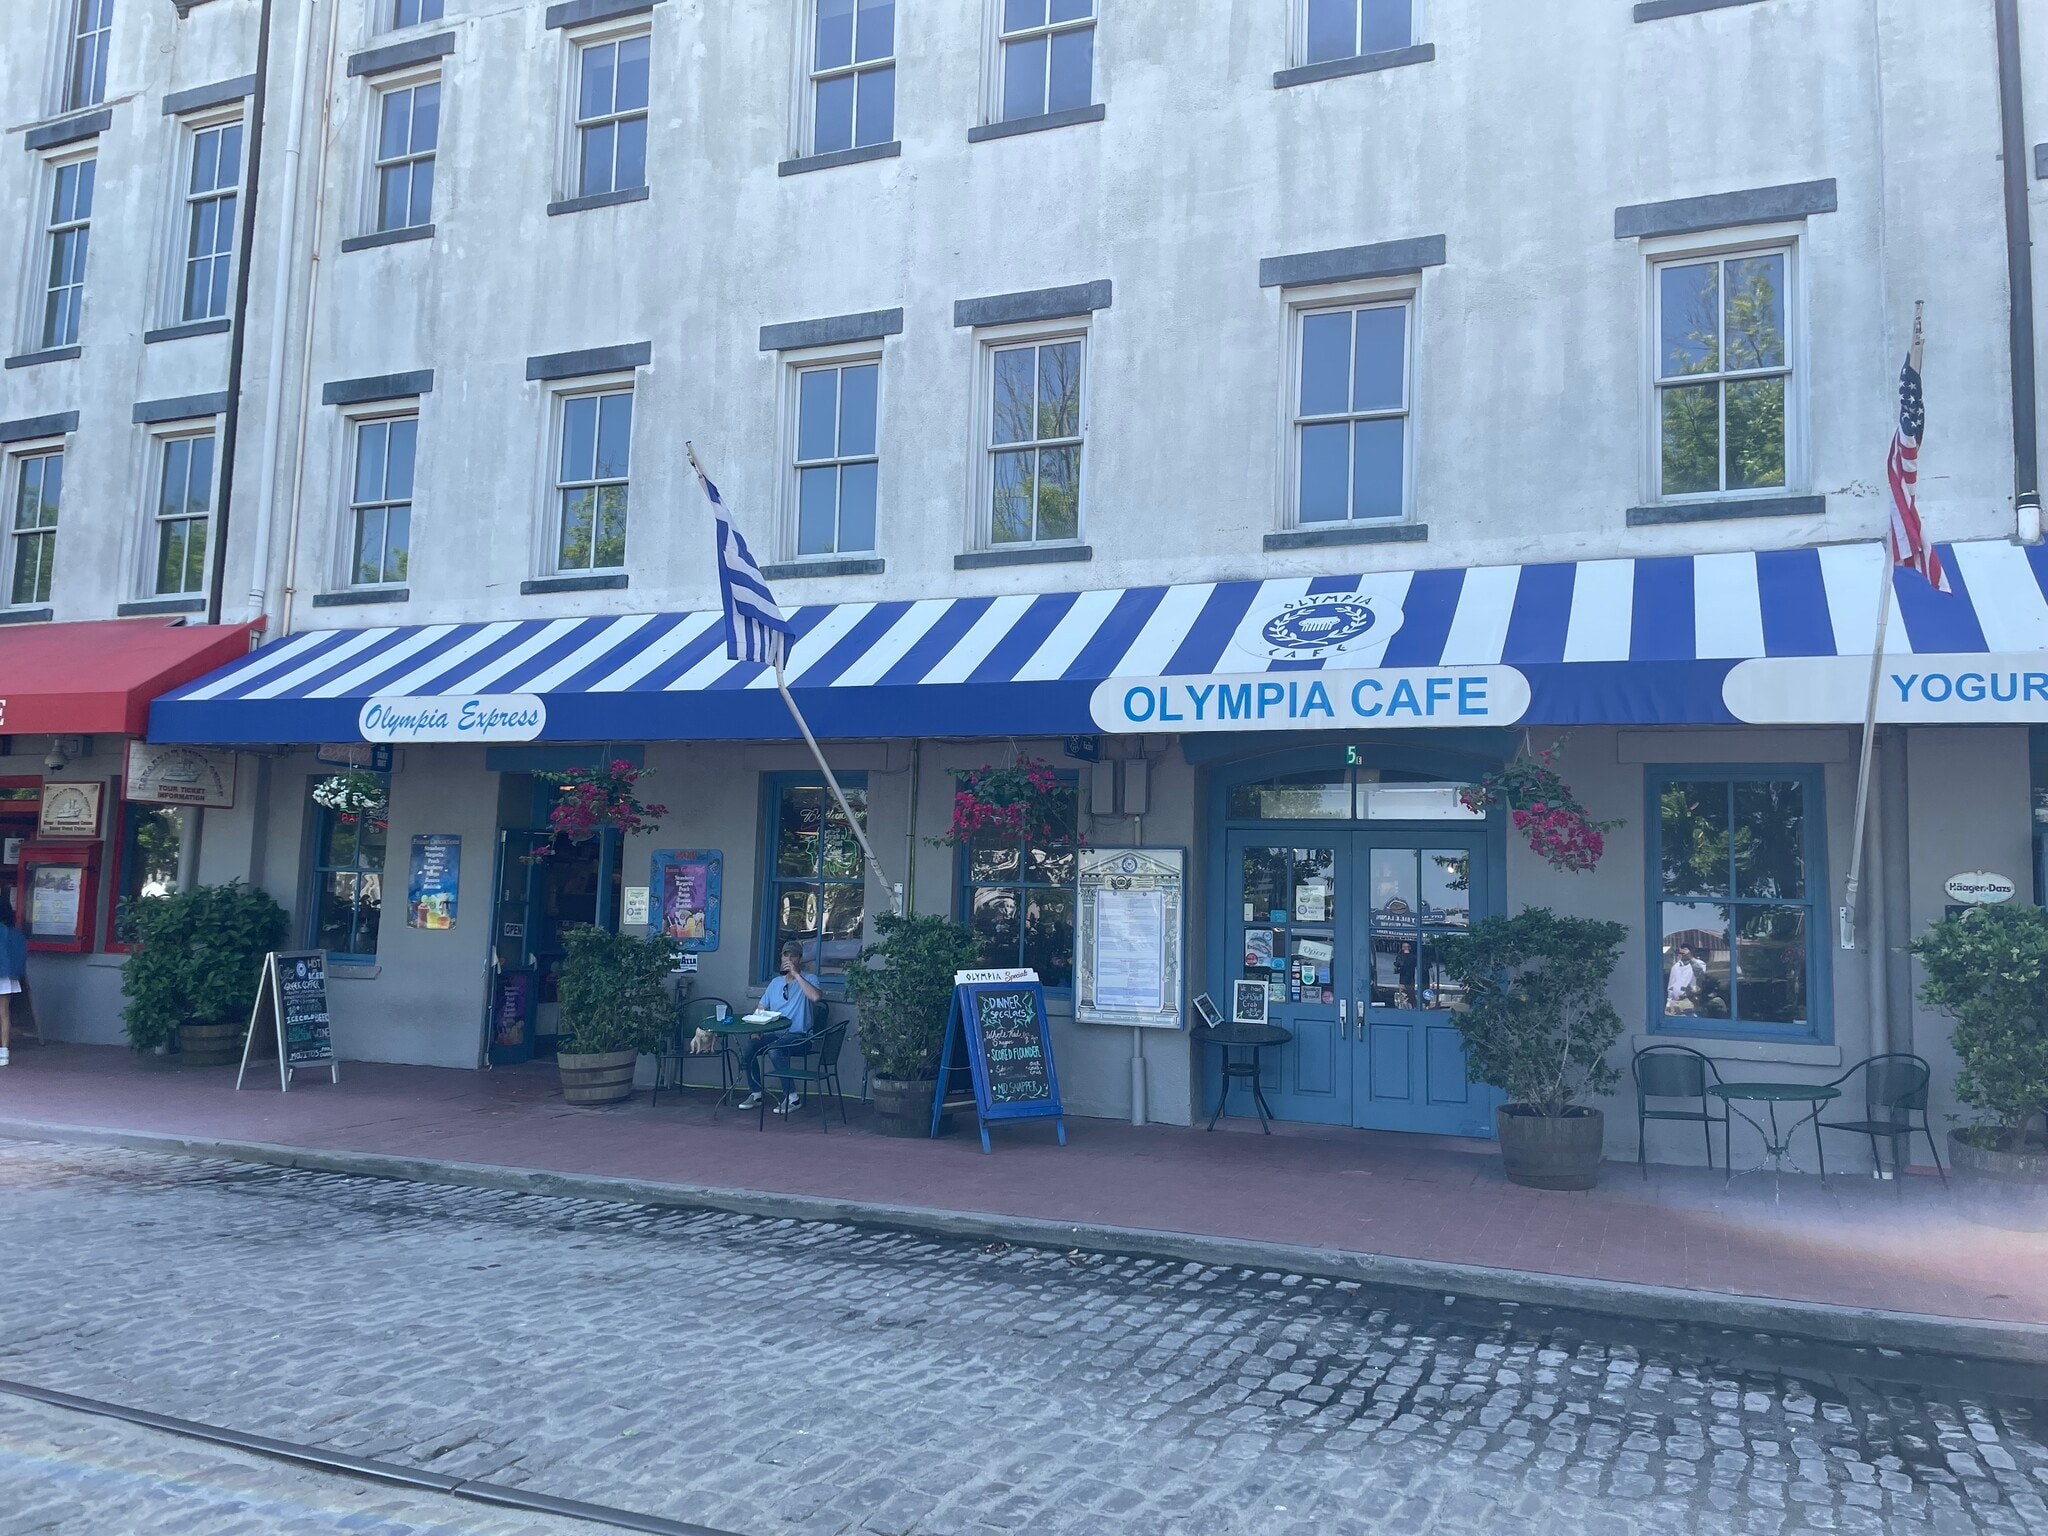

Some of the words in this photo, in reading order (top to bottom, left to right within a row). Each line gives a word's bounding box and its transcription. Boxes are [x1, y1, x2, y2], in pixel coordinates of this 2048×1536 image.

[1284, 595, 1372, 609] OLYMPIA
[1269, 644, 1347, 658] CAFE
[1890, 673, 2048, 702] YOGUR
[1123, 680, 1335, 723] OLYMPIA
[1351, 676, 1489, 719] CAFE
[365, 704, 449, 737] Olympia
[457, 700, 539, 735] Express
[1348, 745, 1356, 764] 5
[157, 792, 205, 801] INFORMATION
[158, 785, 178, 793] TOUR
[181, 786, 206, 794] TICKET
[505, 924, 522, 935] OPEN
[1303, 946, 1327, 957] Open
[966, 973, 1002, 981] OLYMPIA
[989, 995, 1022, 1010] DINNER
[1242, 1000, 1258, 1008] Crab
